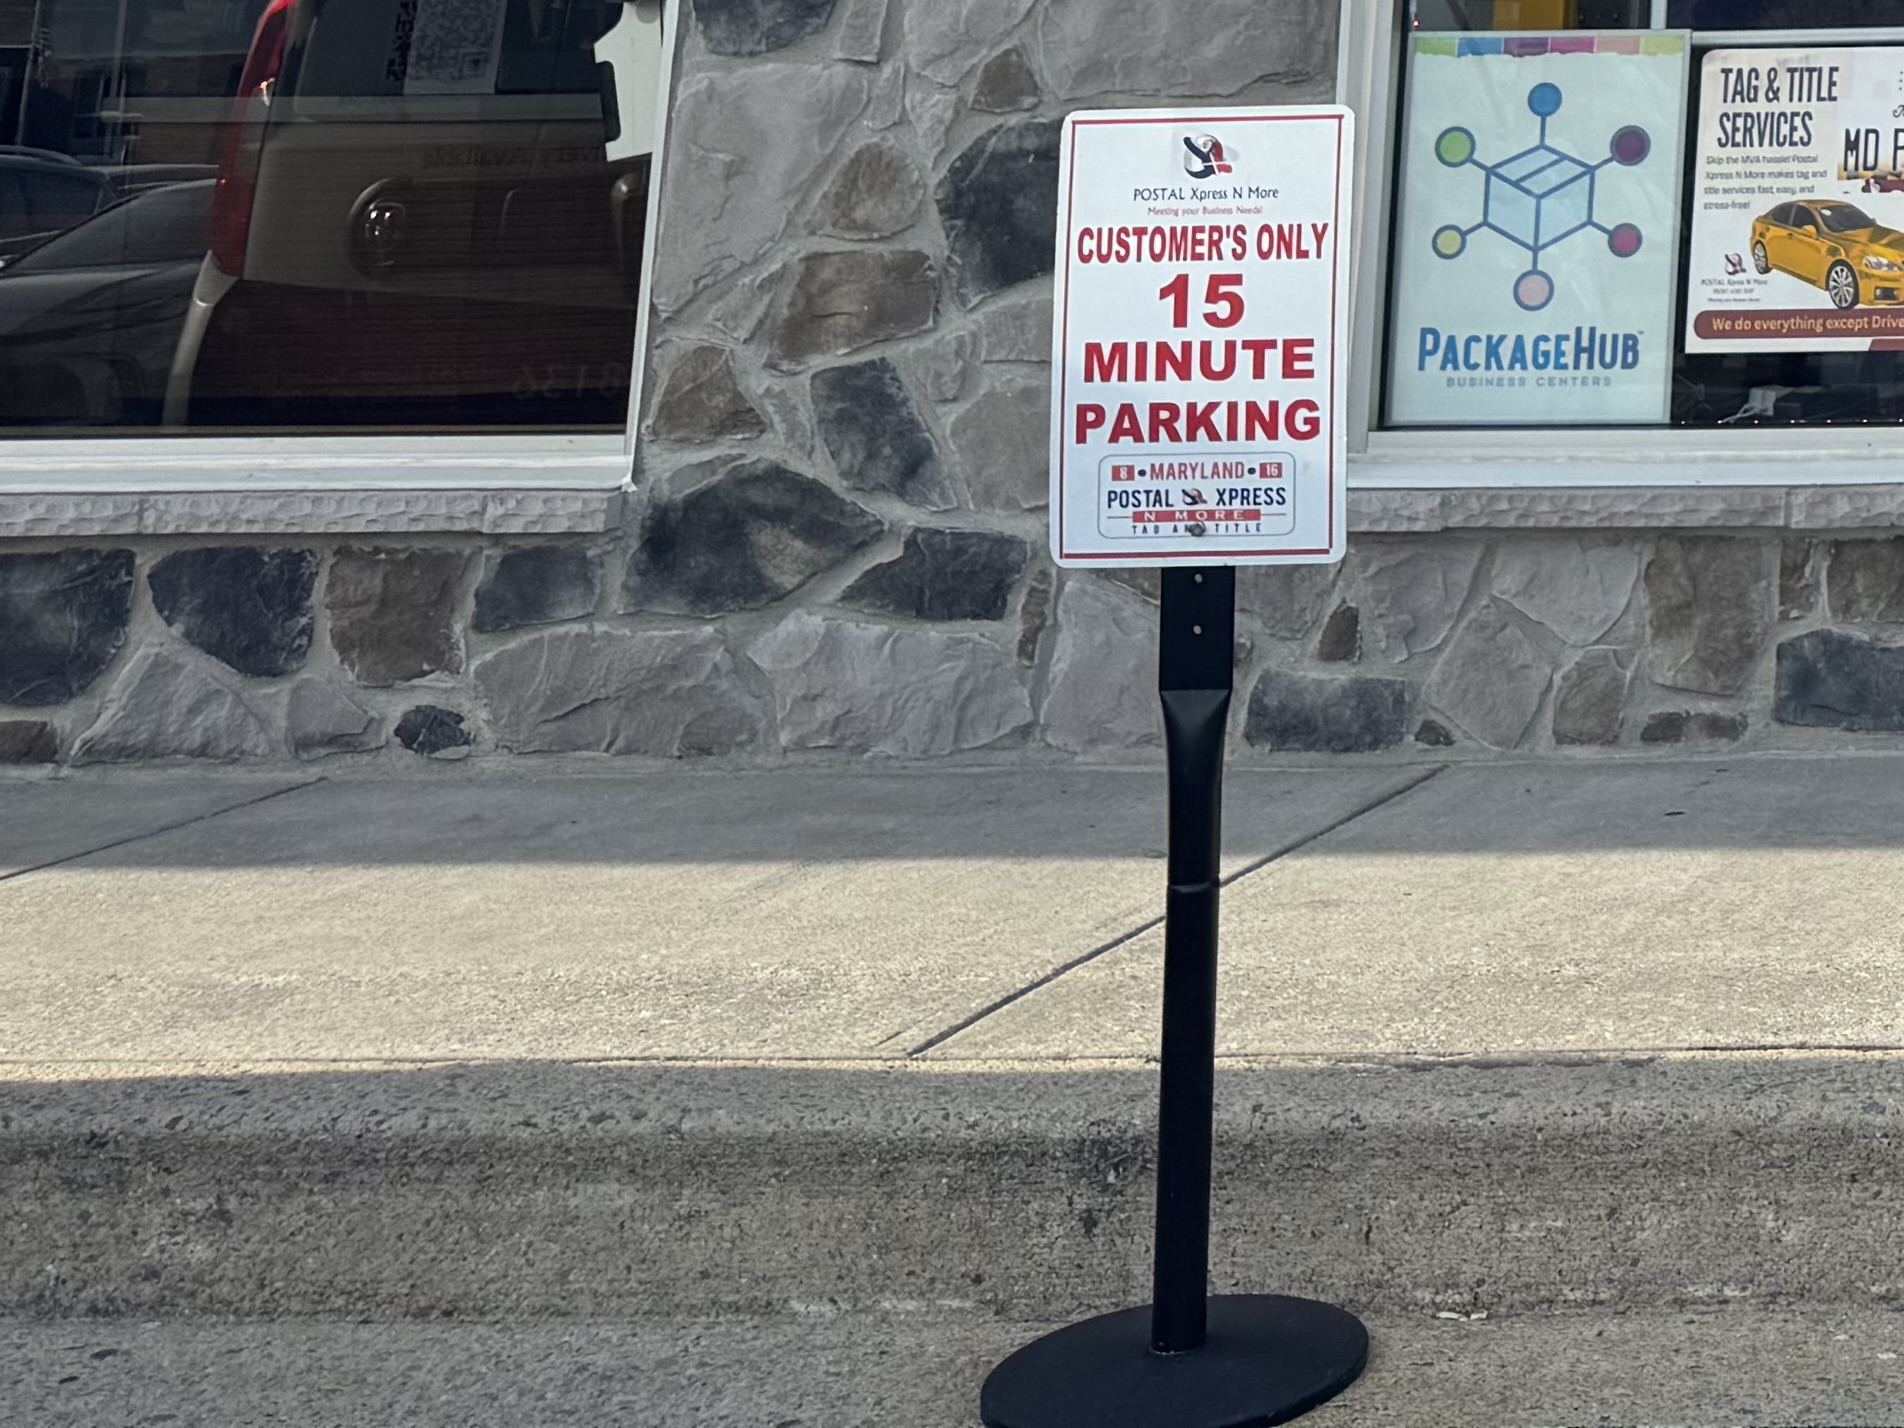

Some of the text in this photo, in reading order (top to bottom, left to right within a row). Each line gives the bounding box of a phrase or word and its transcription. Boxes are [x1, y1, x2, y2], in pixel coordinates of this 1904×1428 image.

[1721, 66, 1839, 103] TAG & TITLE
[1717, 111, 1814, 148] SERVICES
[1843, 128, 1880, 172] MD
[1077, 222, 1329, 264] CUSTOMER'S ONLY
[1158, 273, 1245, 329] 15
[1711, 316, 1738, 331] We
[1740, 316, 1754, 330] do
[1754, 315, 1823, 334] everything
[1826, 316, 1868, 333] except
[1083, 338, 1315, 383] MINUTE
[1446, 375, 1612, 388] BUSINESS CENTERS
[1075, 398, 1321, 445] PARKING
[1150, 461, 1246, 480] MARYLAND
[1107, 487, 1287, 509] POSTAL XPRESS
